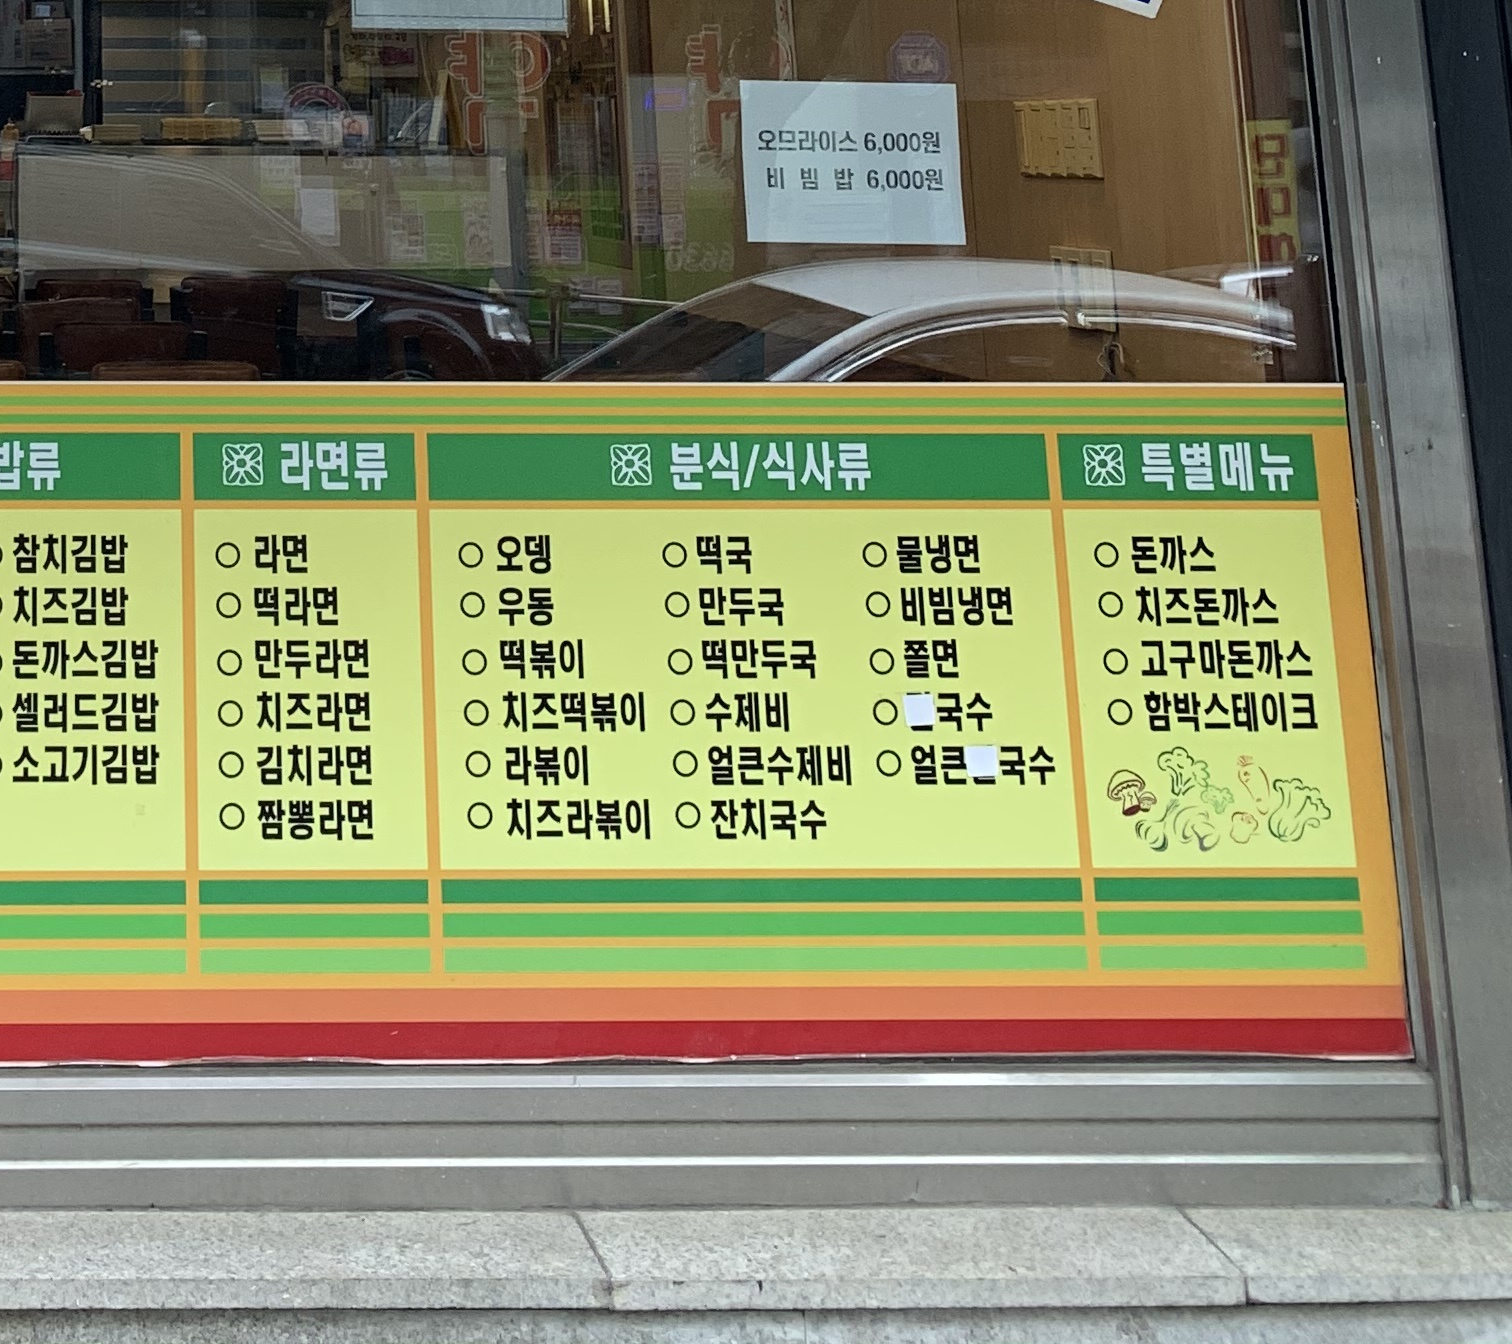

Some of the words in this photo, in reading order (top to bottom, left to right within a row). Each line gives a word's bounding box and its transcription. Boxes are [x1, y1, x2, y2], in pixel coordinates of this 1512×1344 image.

[758, 130, 857, 152] 오므라이스
[864, 132, 941, 154] 6,000원
[767, 168, 854, 190] 비빔밥
[867, 169, 944, 192] 6,000원
[279, 441, 388, 491] 라면류
[668, 442, 872, 491] 분식/식사류
[1141, 443, 1294, 492] 특별메뉴
[12, 533, 128, 574] 참치김밥
[254, 535, 309, 574] 라면
[496, 535, 552, 574] 오뎅
[695, 535, 752, 574] 떡국
[896, 535, 980, 574] 물냉면
[1130, 535, 1217, 574] 돈까스
[12, 586, 128, 627] 치즈김밥
[254, 586, 339, 626] 떡라면
[498, 586, 554, 626] 우동
[698, 586, 785, 626] 만두국
[900, 586, 1013, 626] 비빔냉면
[1135, 586, 1280, 626] 치즈돈까스
[11, 638, 158, 680] 돈까스김밥
[254, 639, 369, 680] 만두라면
[500, 638, 585, 680] 떡볶이
[701, 639, 817, 679] 떡만두국
[903, 639, 959, 679] 쫄면
[1141, 639, 1313, 679] 고구마돈까스
[256, 691, 371, 733] 치즈라면
[503, 692, 646, 732] 치즈떡볶이
[705, 692, 790, 732] 수제비
[904, 691, 993, 732] 국수
[1143, 692, 1319, 732] 함박스테이크
[12, 743, 159, 785] 소고기김밥
[256, 745, 372, 786] 김치라면
[505, 745, 589, 786] 라볶이
[707, 746, 853, 786] 얼큰수제비
[910, 746, 1056, 786] 얼큰국수
[257, 799, 374, 841] 짬뽕라면
[507, 799, 651, 840] 치즈라볶이
[710, 798, 827, 840] 잔치국수
